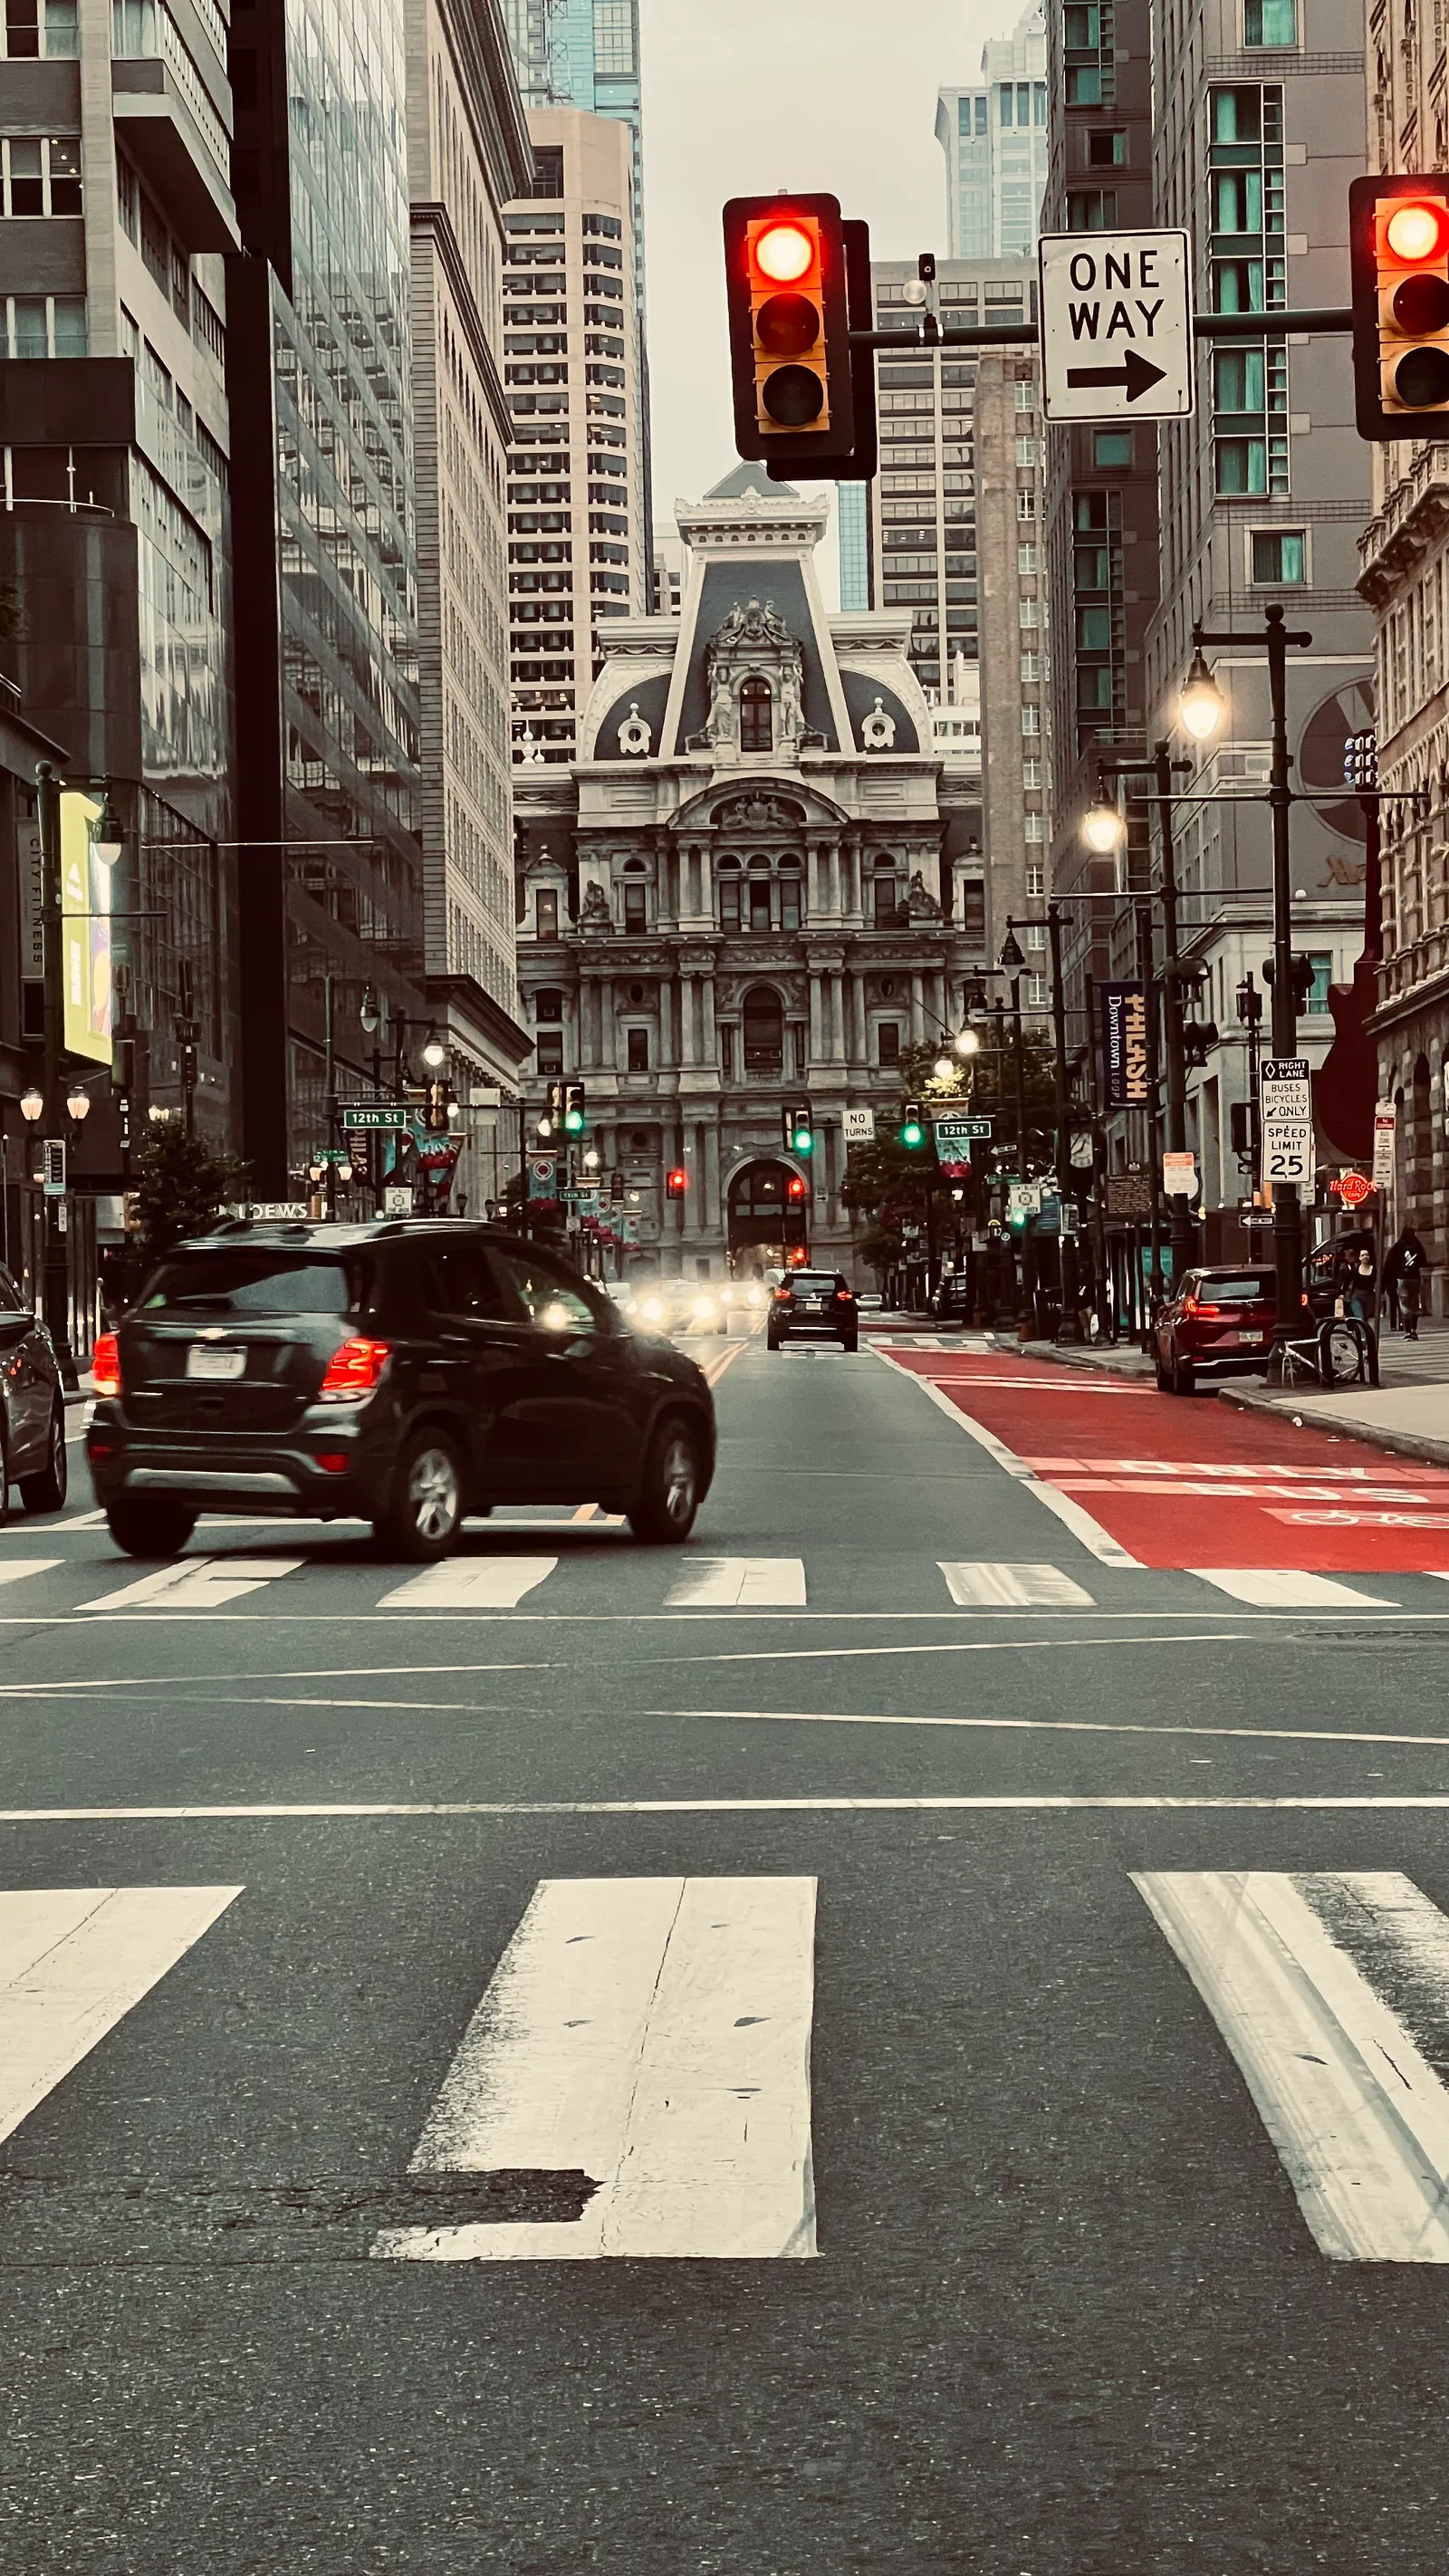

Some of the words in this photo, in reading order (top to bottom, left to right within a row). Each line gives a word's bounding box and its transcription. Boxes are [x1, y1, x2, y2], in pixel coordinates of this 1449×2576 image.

[1070, 249, 1160, 292] ONE
[1068, 298, 1165, 340] WAY
[30, 838, 43, 882] CITY
[1108, 995, 1122, 1069] Downtown
[1124, 993, 1147, 1099] PHLASH
[1278, 1061, 1307, 1070] RIGHT
[1279, 1070, 1305, 1078] LANE
[1271, 1082, 1300, 1092] BUSES
[1265, 1094, 1307, 1104] BICYCLES
[352, 1113, 379, 1123] 12th
[384, 1112, 398, 1123] St
[1278, 1106, 1307, 1117] ONLY
[849, 1113, 866, 1123] NO
[844, 1127, 873, 1138] TURNS
[944, 1125, 968, 1136] 12th
[972, 1124, 984, 1134] St
[1267, 1127, 1307, 1139] SPEED
[1271, 1140, 1302, 1151] LIMIT
[1270, 1154, 1303, 1176] 25
[1329, 1179, 1354, 1192] Hard
[238, 1203, 308, 1220] LOEWS
[1118, 1459, 1377, 1480] ONLY
[1182, 1481, 1430, 1504] BUS
